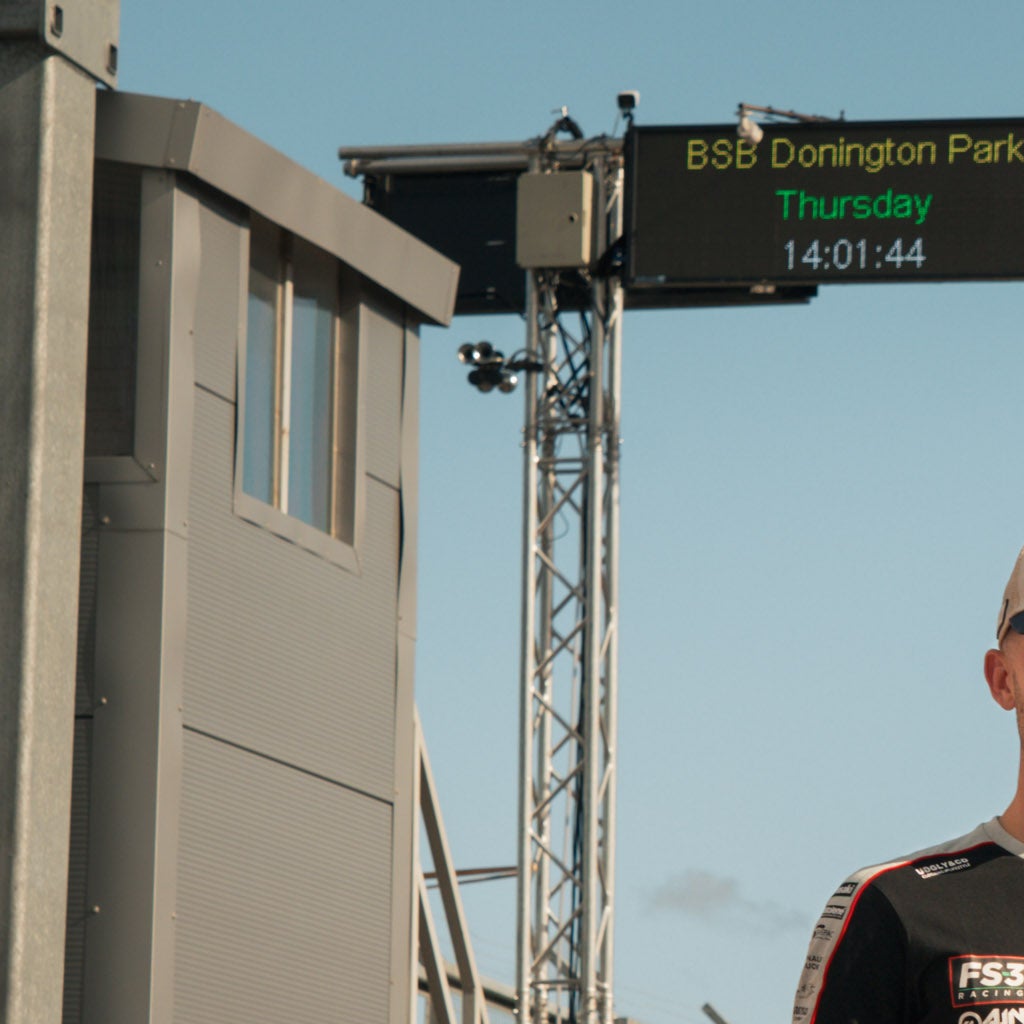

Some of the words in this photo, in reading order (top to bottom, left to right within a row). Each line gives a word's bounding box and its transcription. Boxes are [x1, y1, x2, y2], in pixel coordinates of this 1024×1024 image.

[687, 138, 758, 170] BSB
[771, 136, 937, 174] Donington
[775, 188, 933, 225] Thursday
[784, 237, 926, 271] 14:01:44
[957, 988, 1024, 1001] RACING
